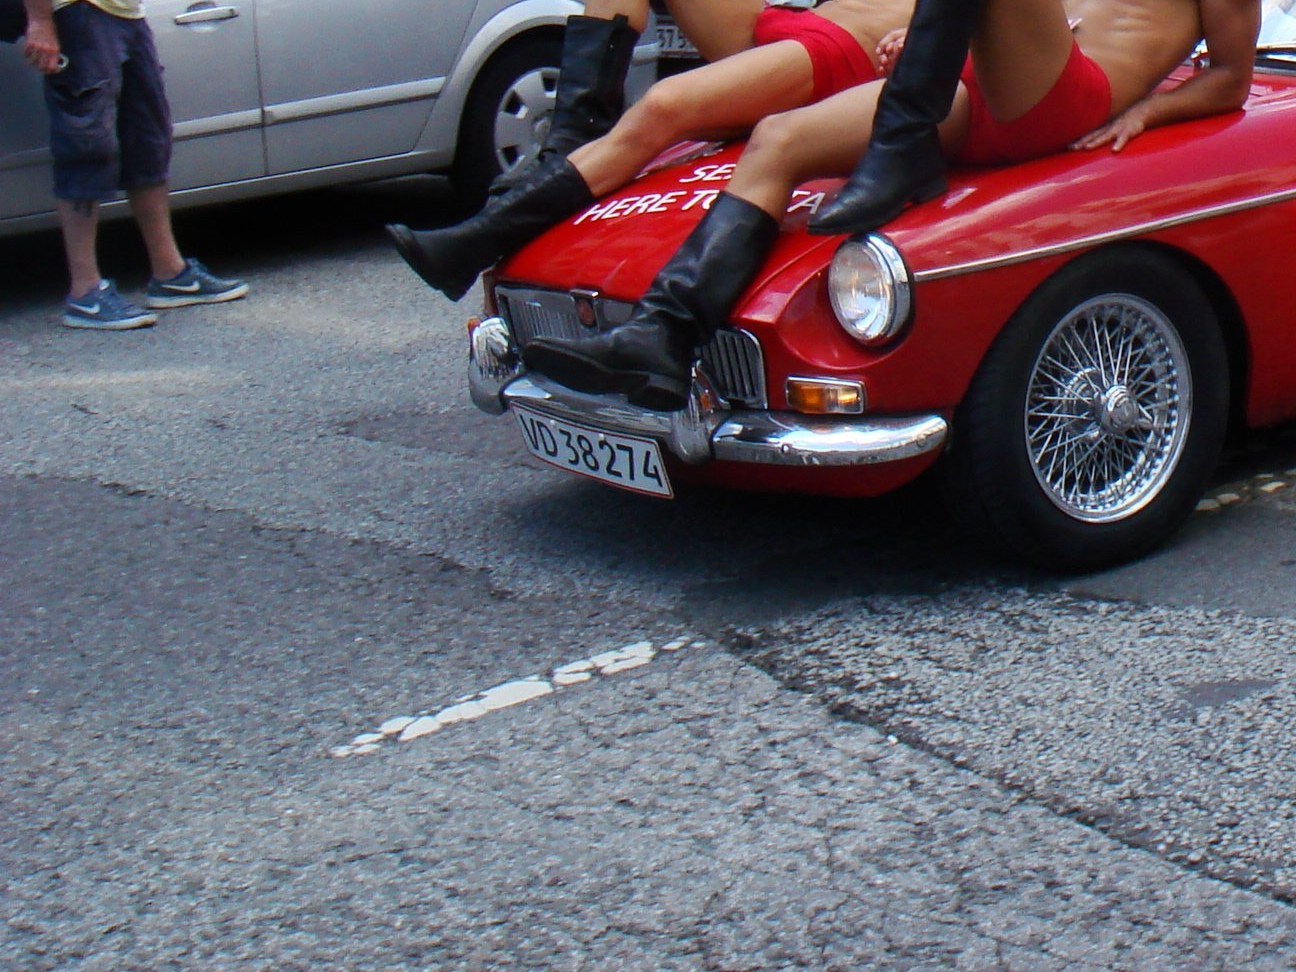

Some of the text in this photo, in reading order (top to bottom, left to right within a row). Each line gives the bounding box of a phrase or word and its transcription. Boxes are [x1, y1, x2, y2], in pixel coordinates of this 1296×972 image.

[679, 164, 737, 182] SE
[574, 190, 688, 225] HERE
[518, 414, 665, 488] VD 38274
